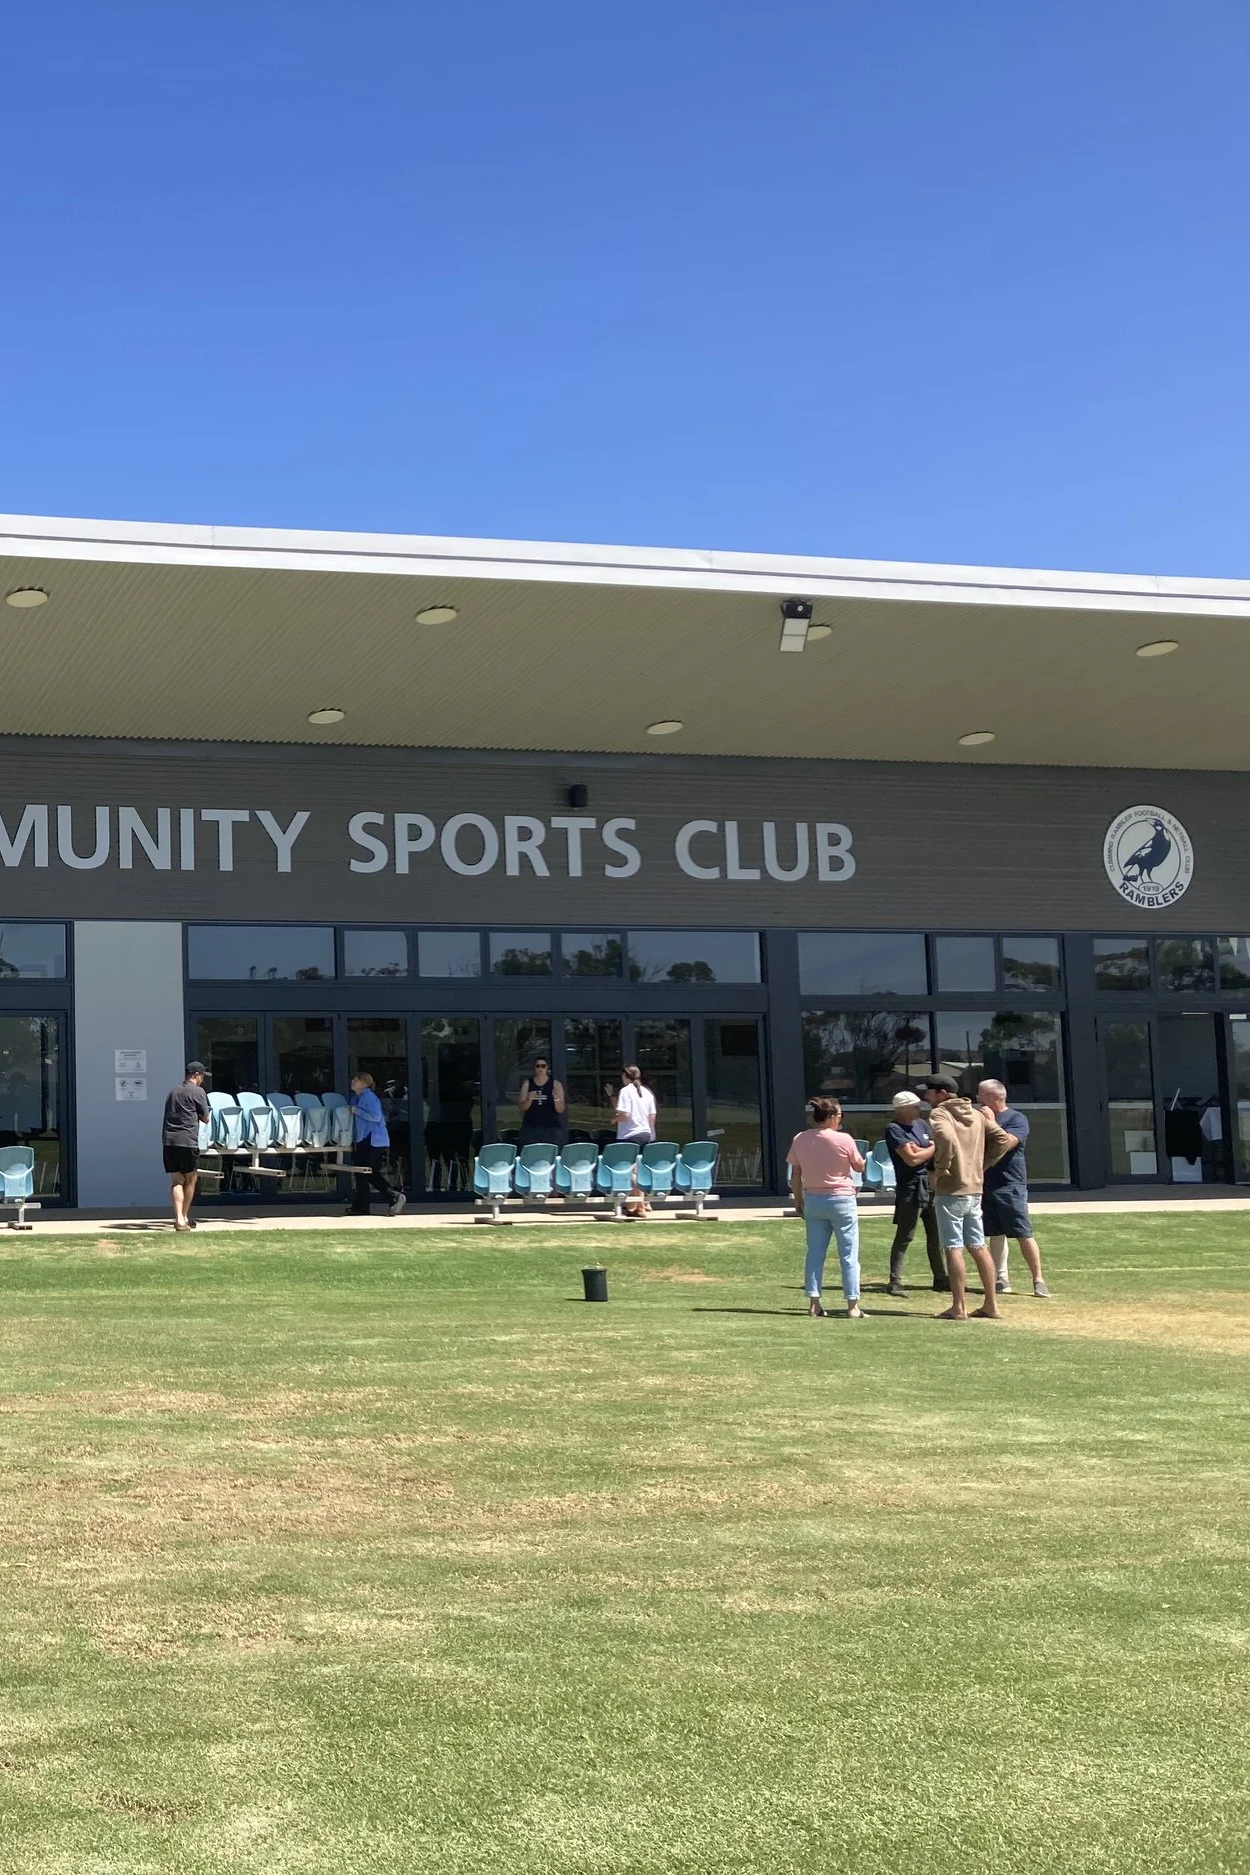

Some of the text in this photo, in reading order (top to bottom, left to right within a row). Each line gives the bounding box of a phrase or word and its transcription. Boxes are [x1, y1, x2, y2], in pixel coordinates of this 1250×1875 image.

[348, 811, 641, 878] SPORTS
[675, 819, 856, 882] CLUB
[1111, 813, 1133, 839] RAMBLER
[1134, 810, 1165, 820] FOOTBALL
[1172, 823, 1190, 853] NETBALL
[1119, 881, 1184, 907] RAMBLERS
